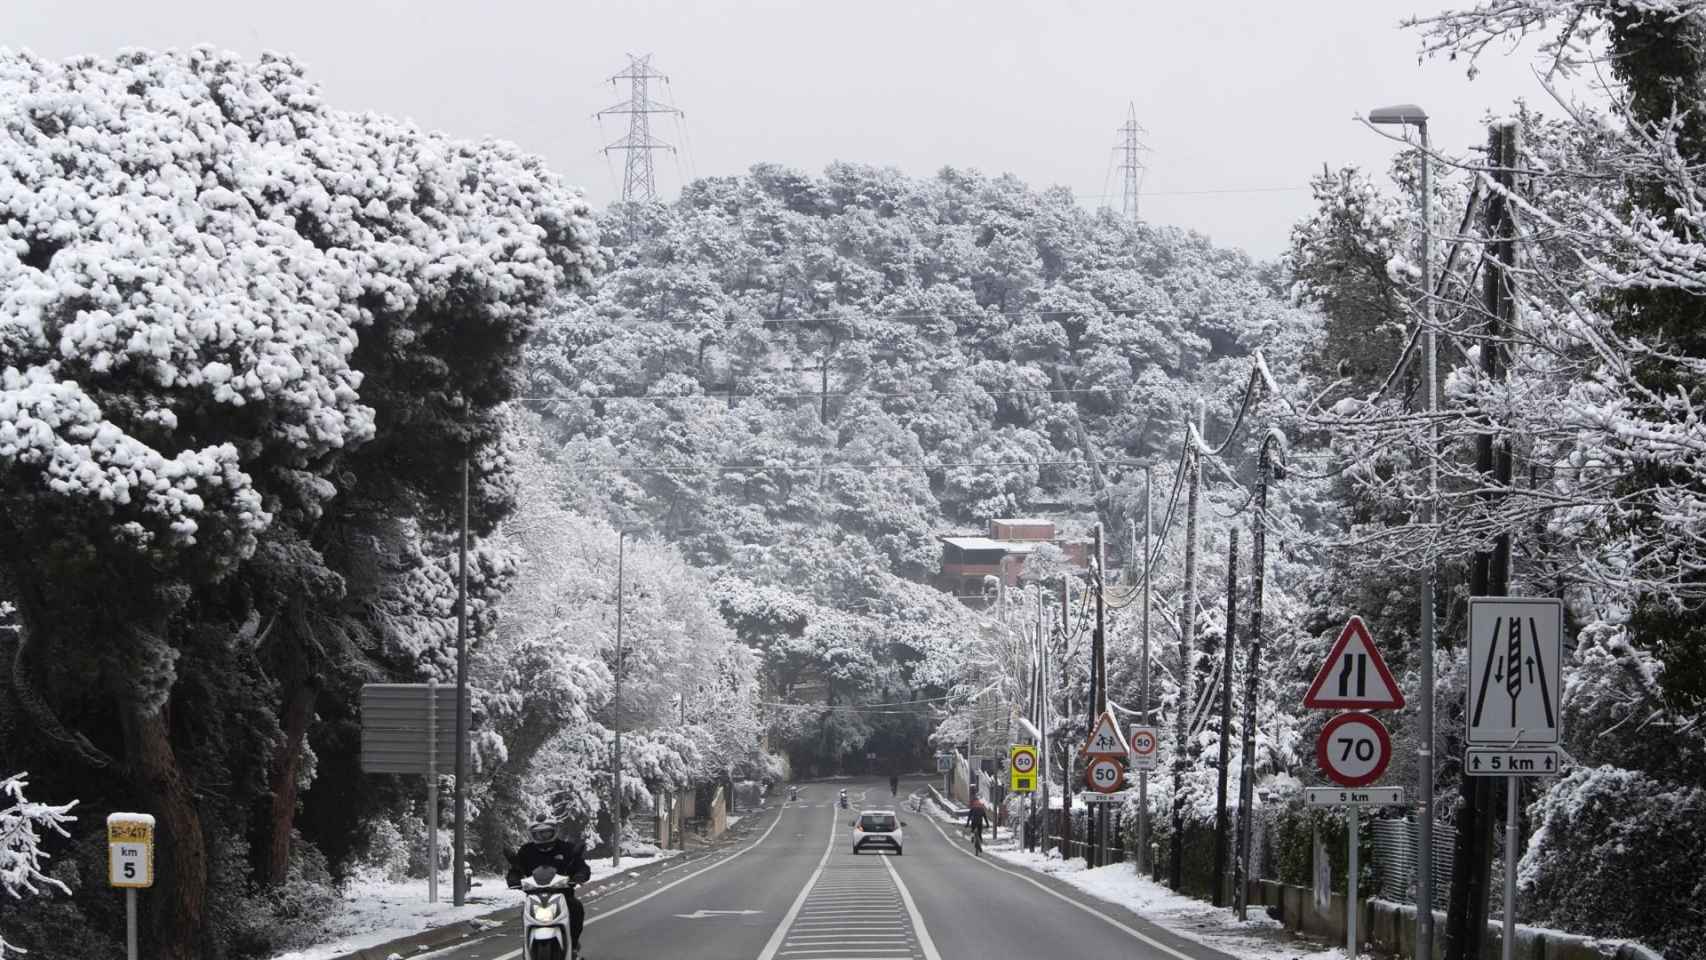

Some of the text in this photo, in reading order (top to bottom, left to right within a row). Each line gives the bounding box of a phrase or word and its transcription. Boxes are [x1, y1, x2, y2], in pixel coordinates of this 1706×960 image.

[1137, 738, 1150, 747] 50
[1337, 738, 1374, 762] 70
[1017, 758, 1030, 766] 50
[1491, 755, 1534, 770] 5 km
[1095, 768, 1116, 781] 50
[1340, 792, 1369, 801] 5 km
[121, 847, 138, 857] km
[124, 862, 136, 879] 5
